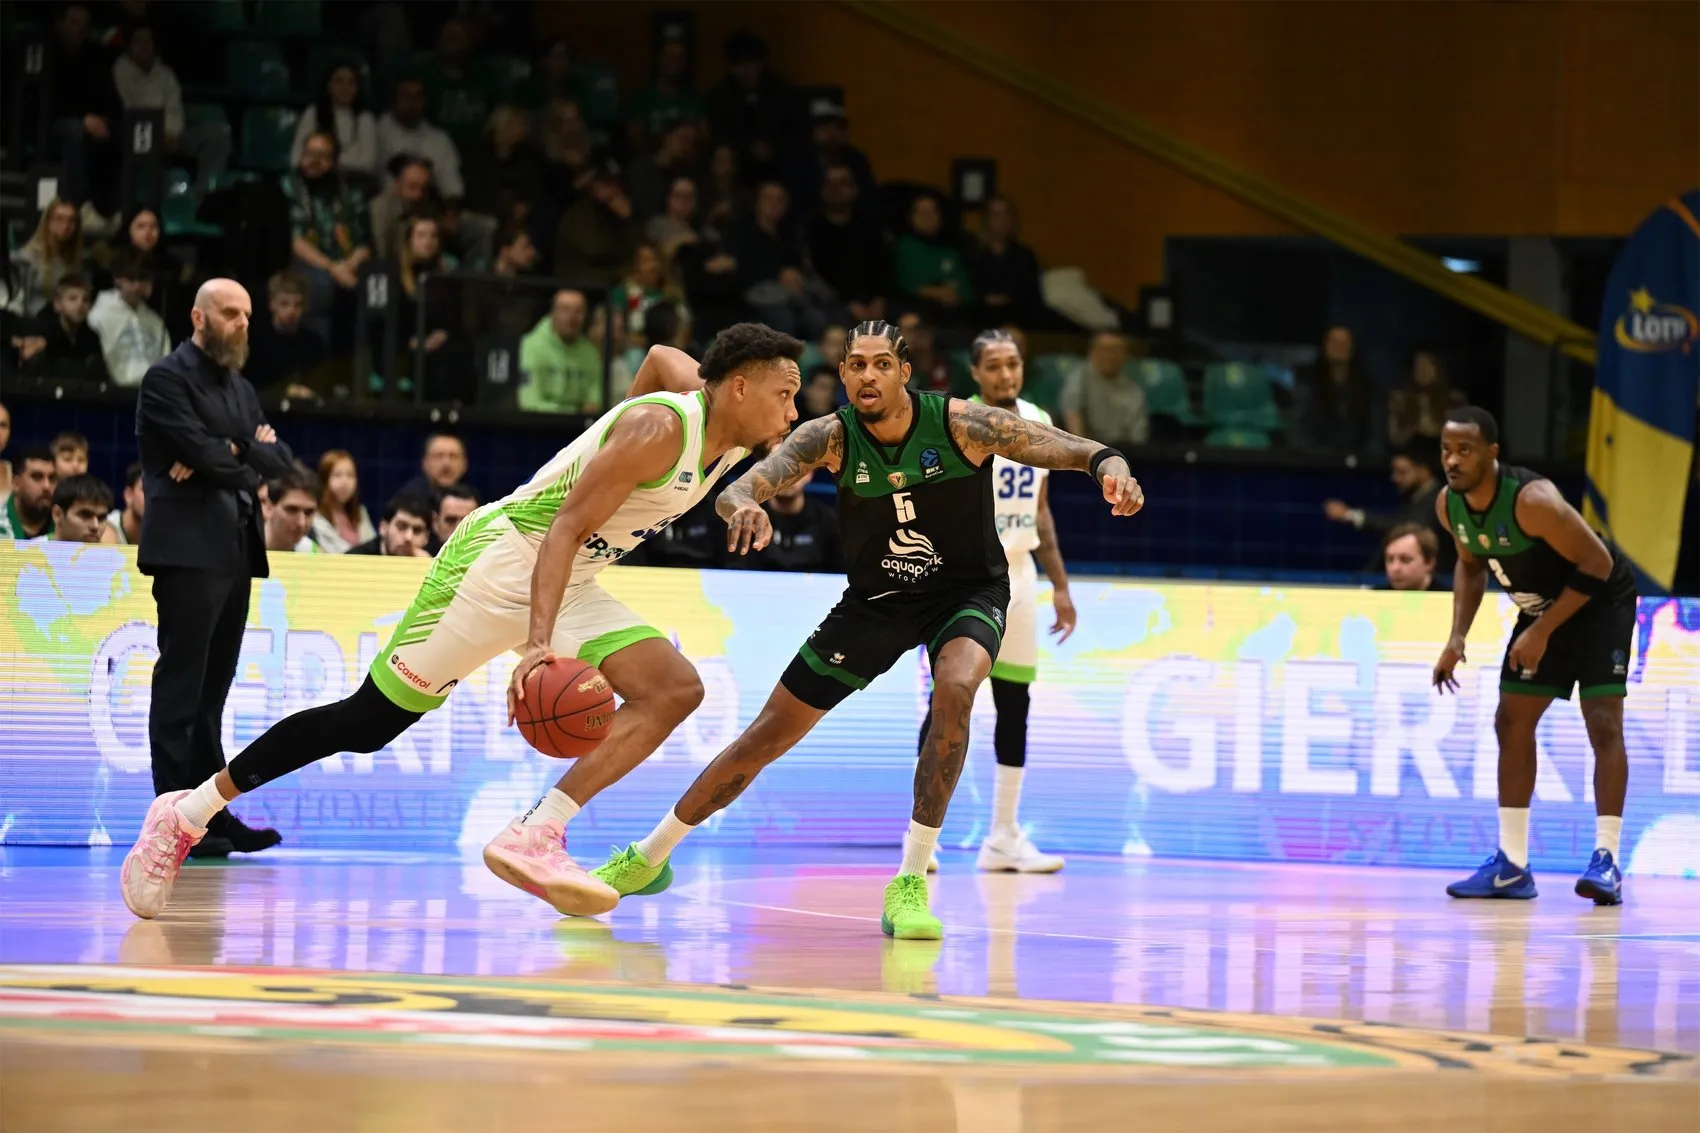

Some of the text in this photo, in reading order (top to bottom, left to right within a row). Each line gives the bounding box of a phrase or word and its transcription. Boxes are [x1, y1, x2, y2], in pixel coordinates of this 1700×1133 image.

[998, 466, 1034, 498] 32
[892, 492, 917, 523] 5
[397, 662, 431, 688] Castrol
